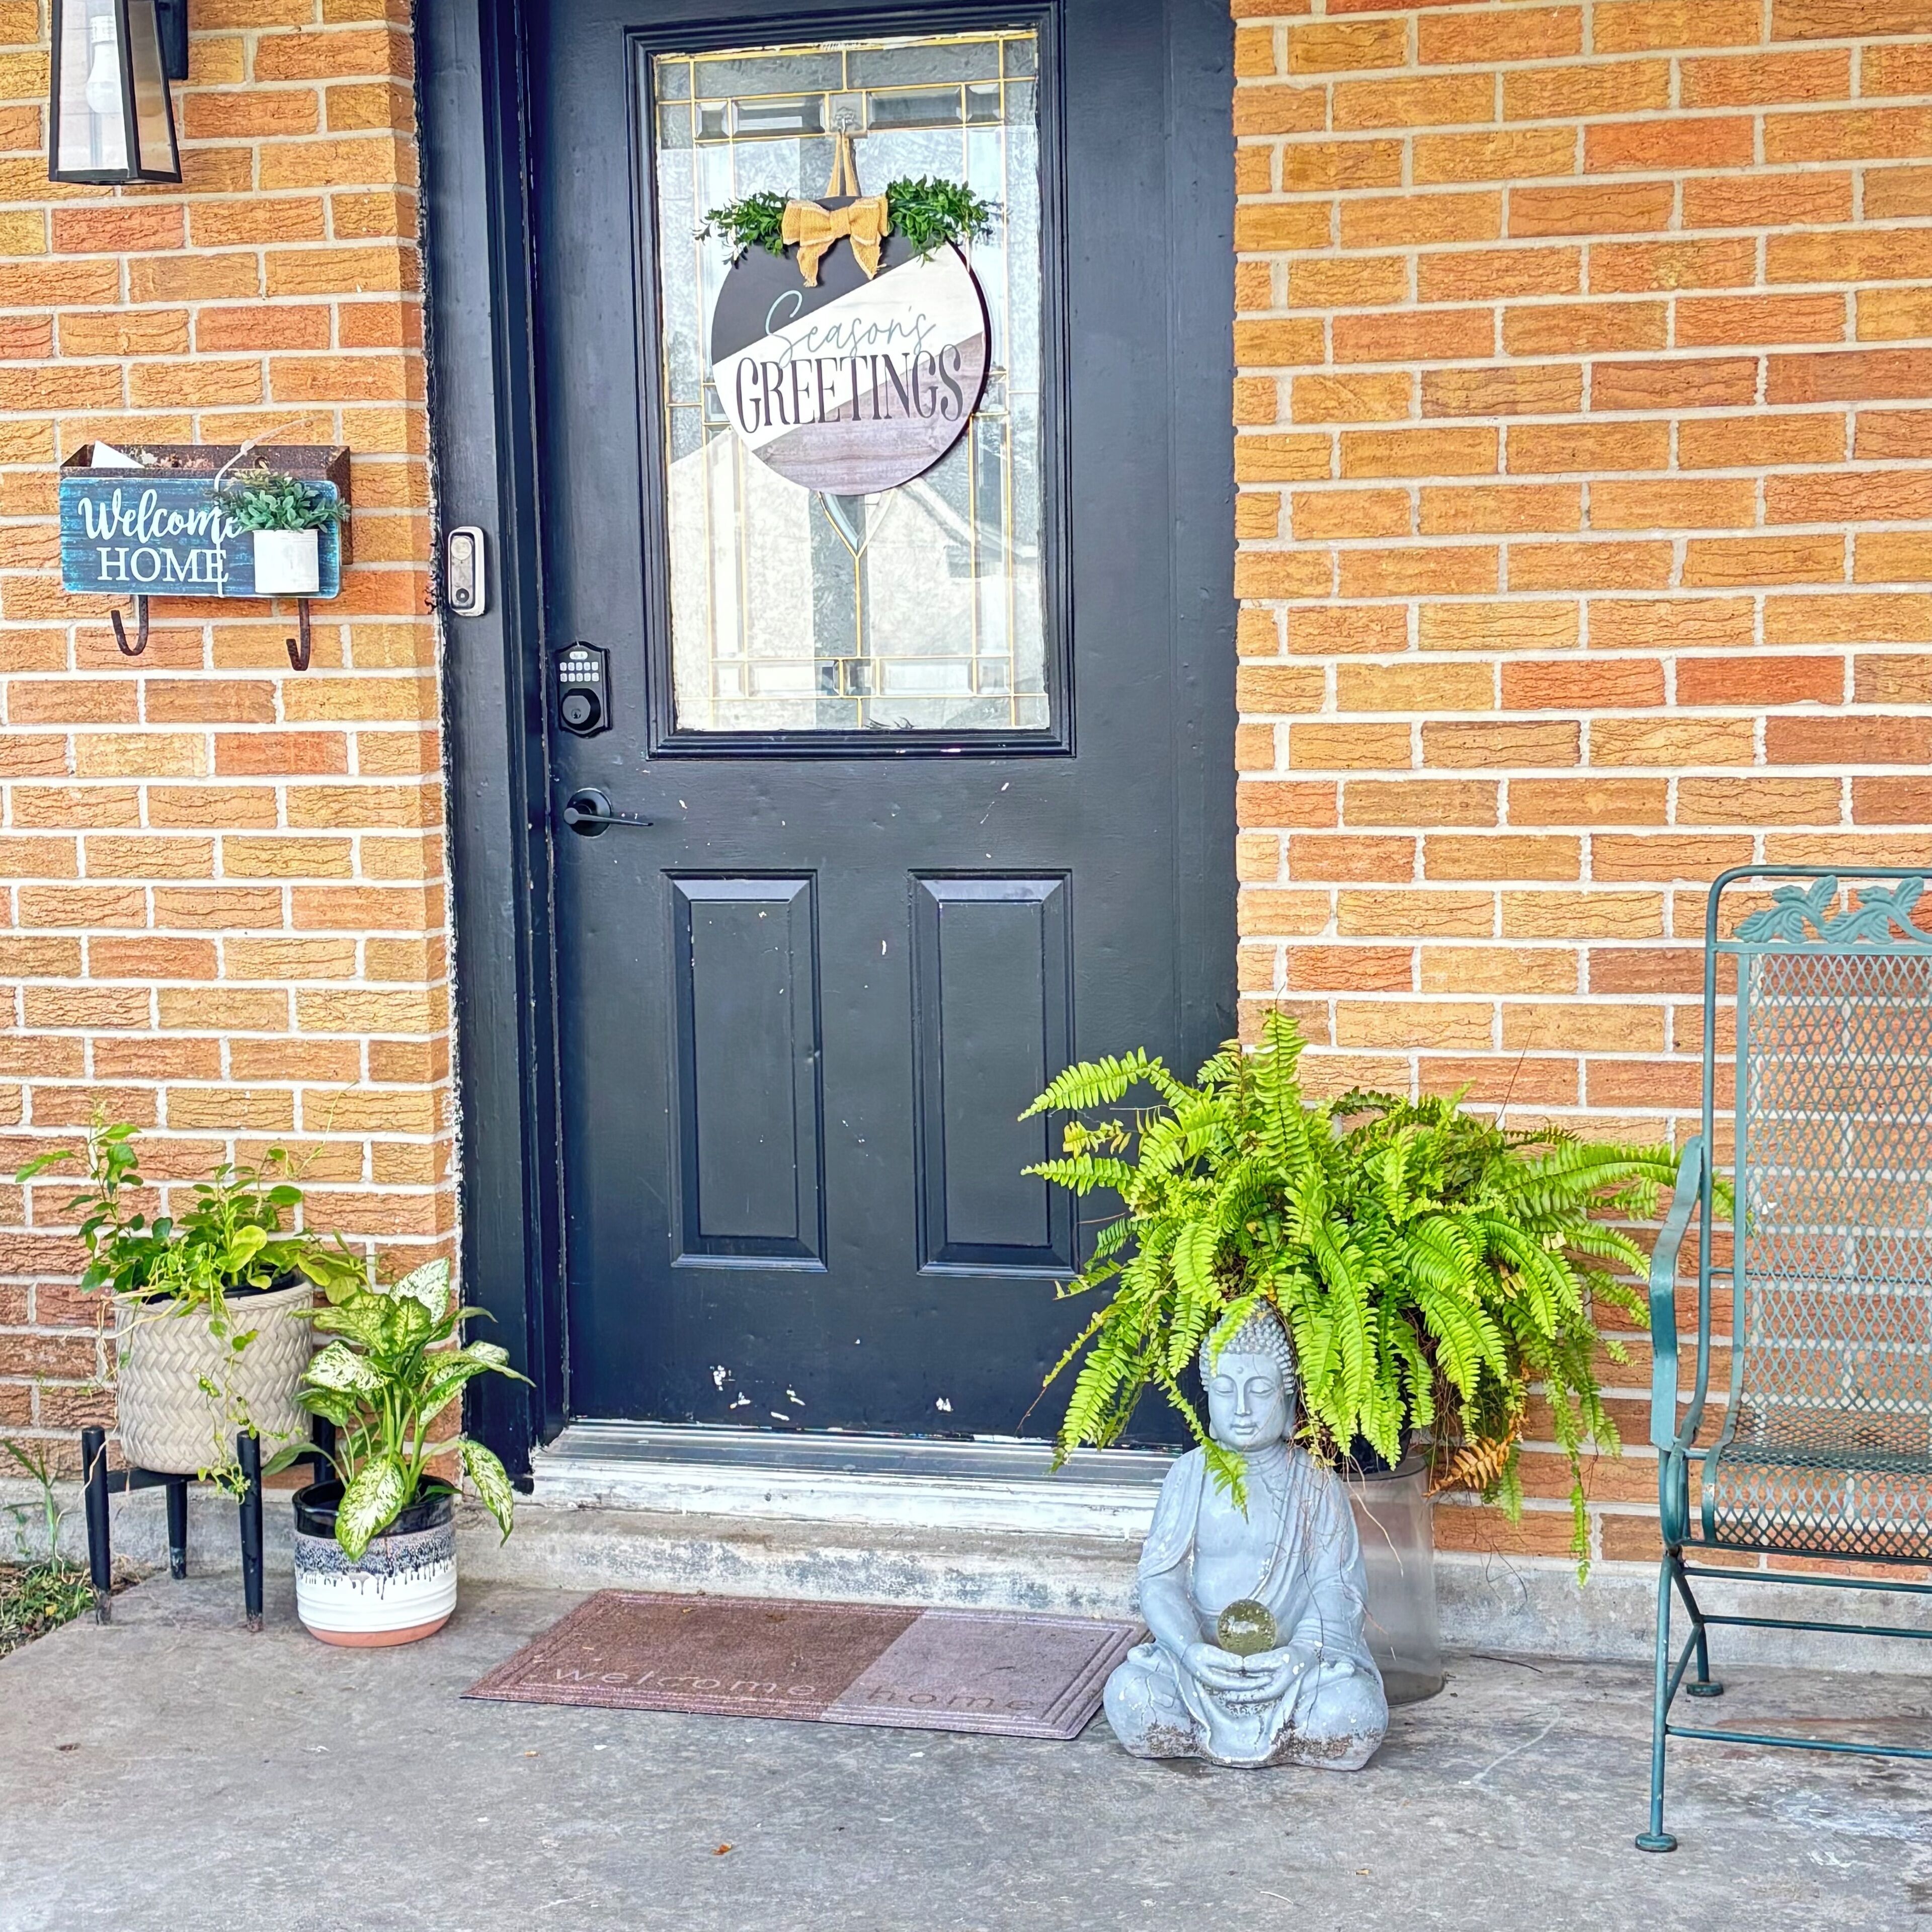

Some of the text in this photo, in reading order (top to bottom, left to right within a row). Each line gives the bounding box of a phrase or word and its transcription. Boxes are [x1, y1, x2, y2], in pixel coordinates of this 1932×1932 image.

[765, 290, 936, 368] Season's
[736, 344, 963, 433] GREETINGS
[97, 546, 229, 583] HOME
[556, 1668, 1035, 1711] welcome home
